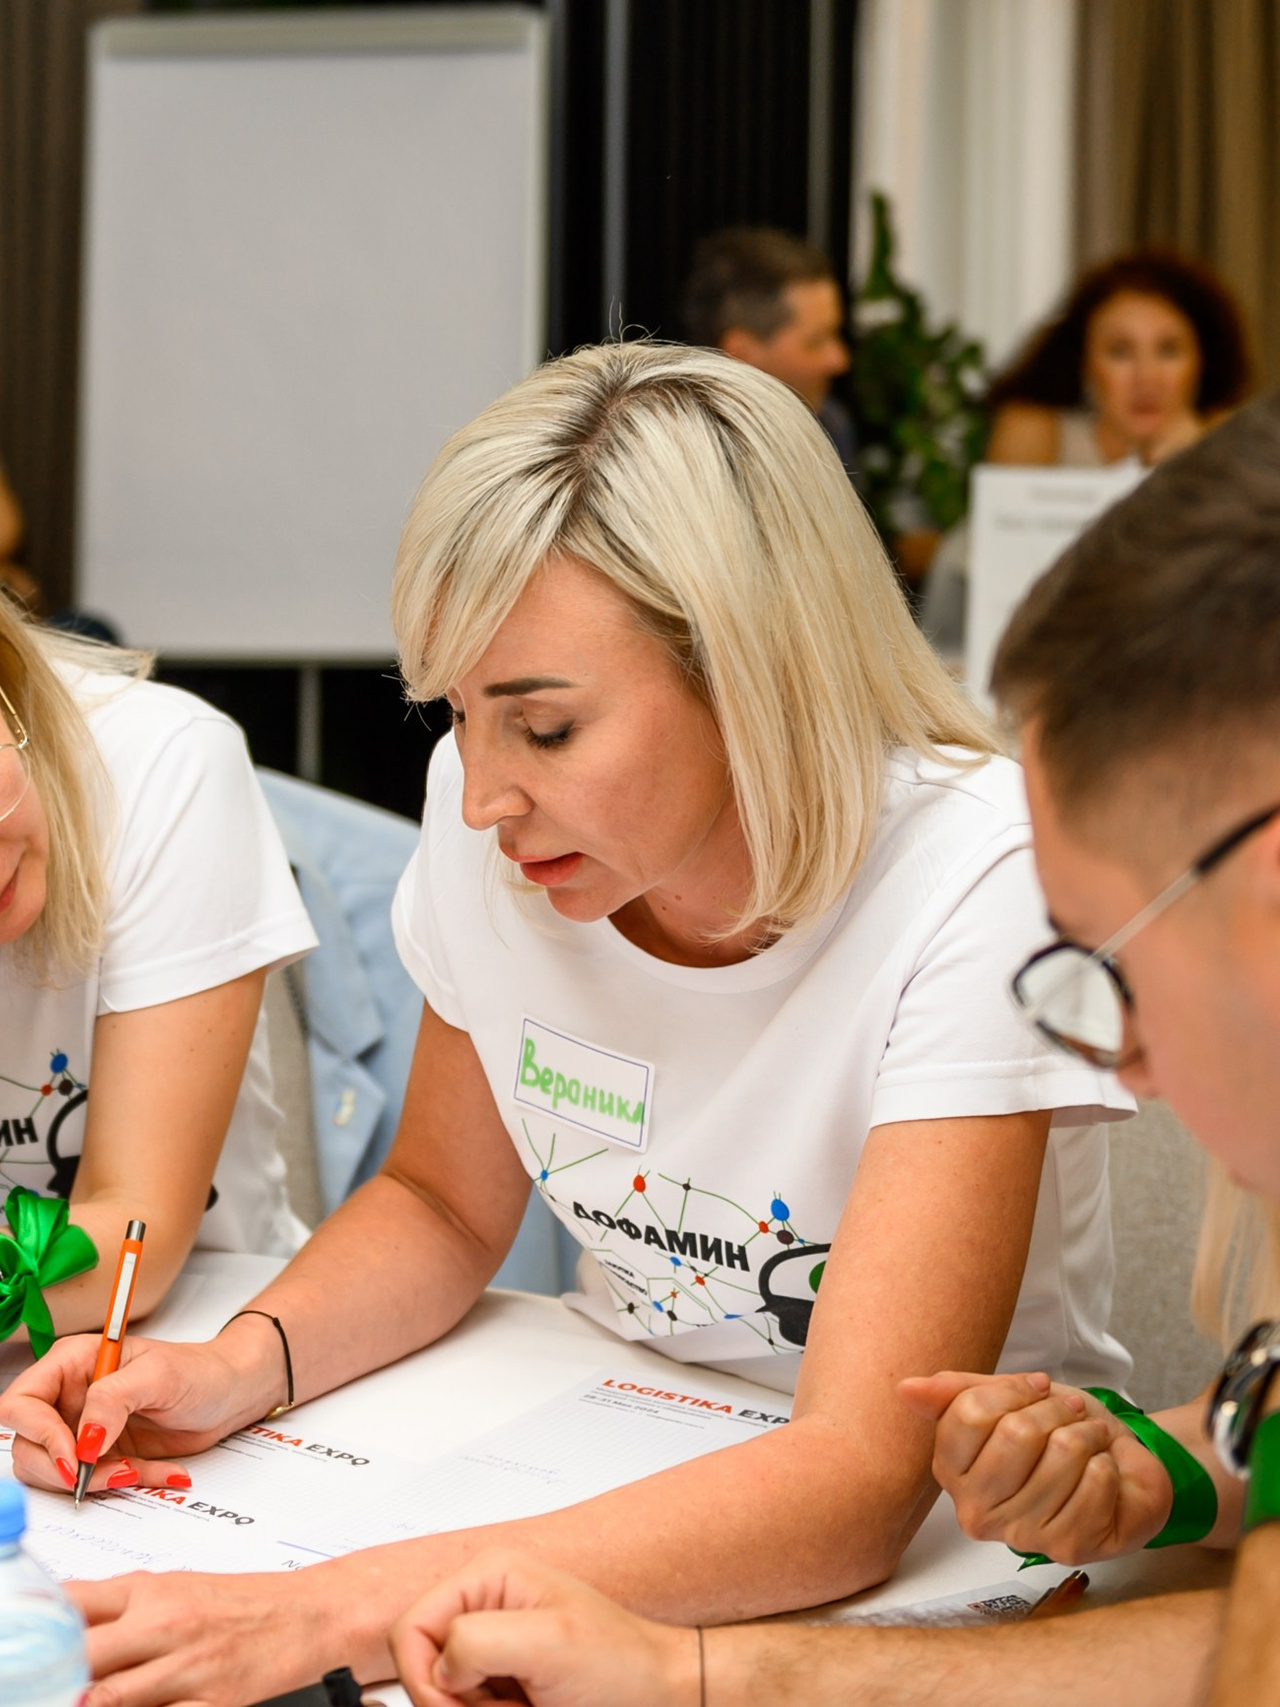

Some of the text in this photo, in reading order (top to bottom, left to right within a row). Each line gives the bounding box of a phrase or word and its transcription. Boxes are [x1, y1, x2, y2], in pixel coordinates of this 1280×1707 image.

[573, 1201, 750, 1272] ДОФАМИН
[602, 1379, 791, 1425] LOGISTIKA EXP
[243, 1425, 370, 1466] TIKA EXPO
[186, 1500, 256, 1526] EXPO
